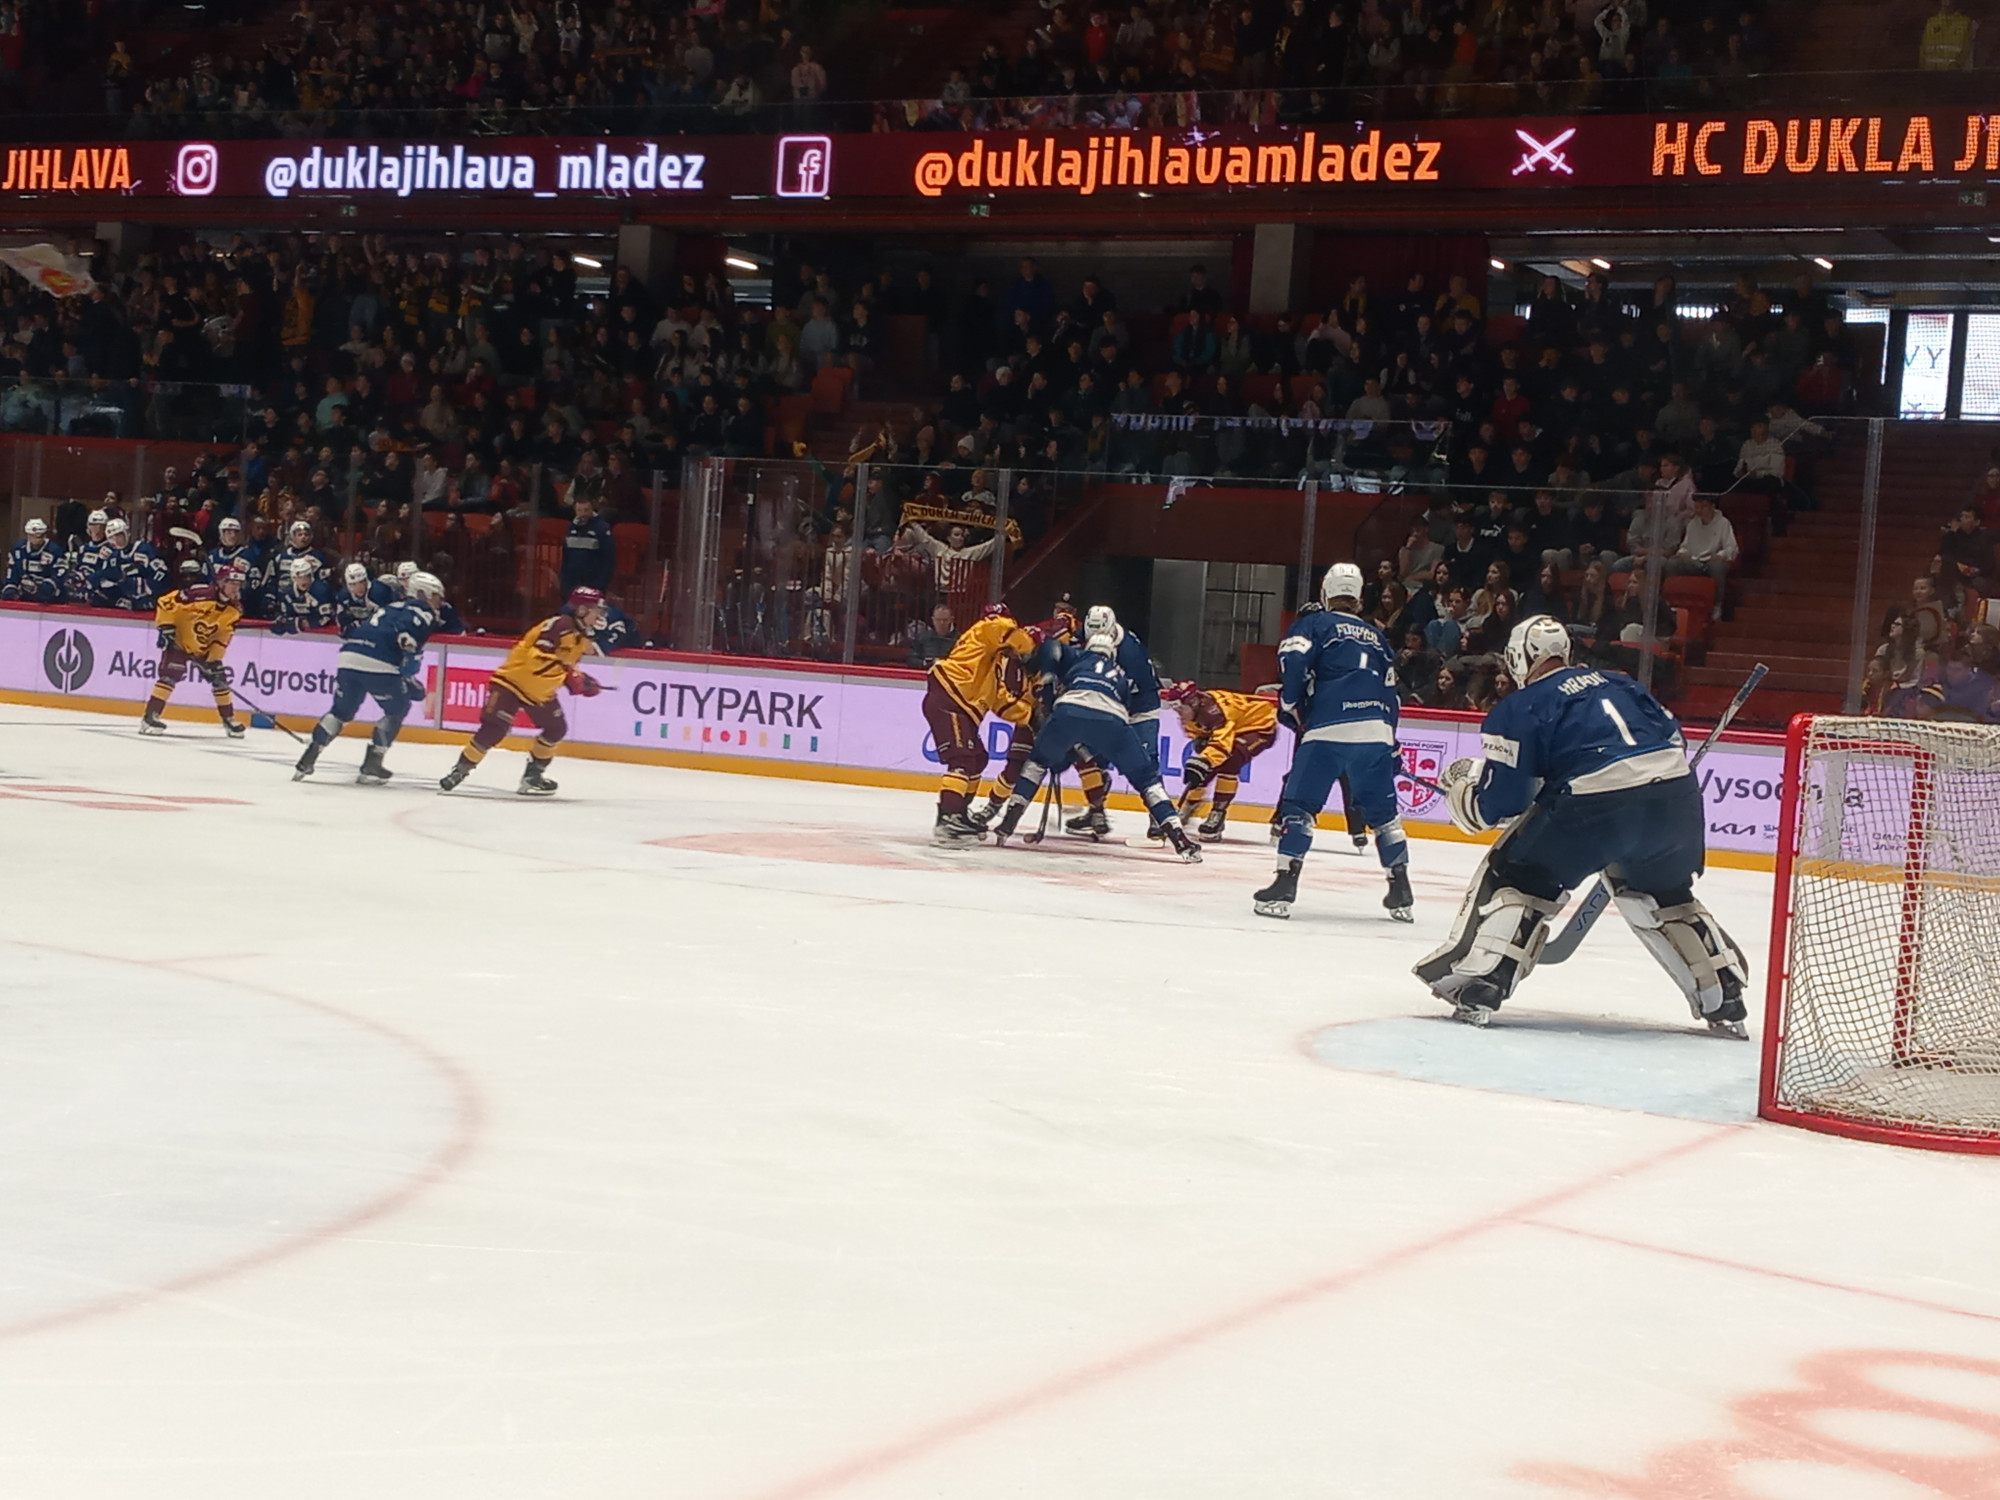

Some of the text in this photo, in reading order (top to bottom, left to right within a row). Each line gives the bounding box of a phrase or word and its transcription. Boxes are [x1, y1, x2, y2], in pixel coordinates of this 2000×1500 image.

[2, 148, 131, 190] JIHLAVA
[265, 143, 705, 197] @duklajihlava_mladez
[914, 130, 1441, 196] @duklajihlavamladez
[1652, 121, 1725, 175] HC
[1743, 117, 1934, 174] DUKLA
[108, 650, 236, 684] Akame
[632, 680, 824, 730] CITYPARK
[1601, 698, 1638, 746] 1
